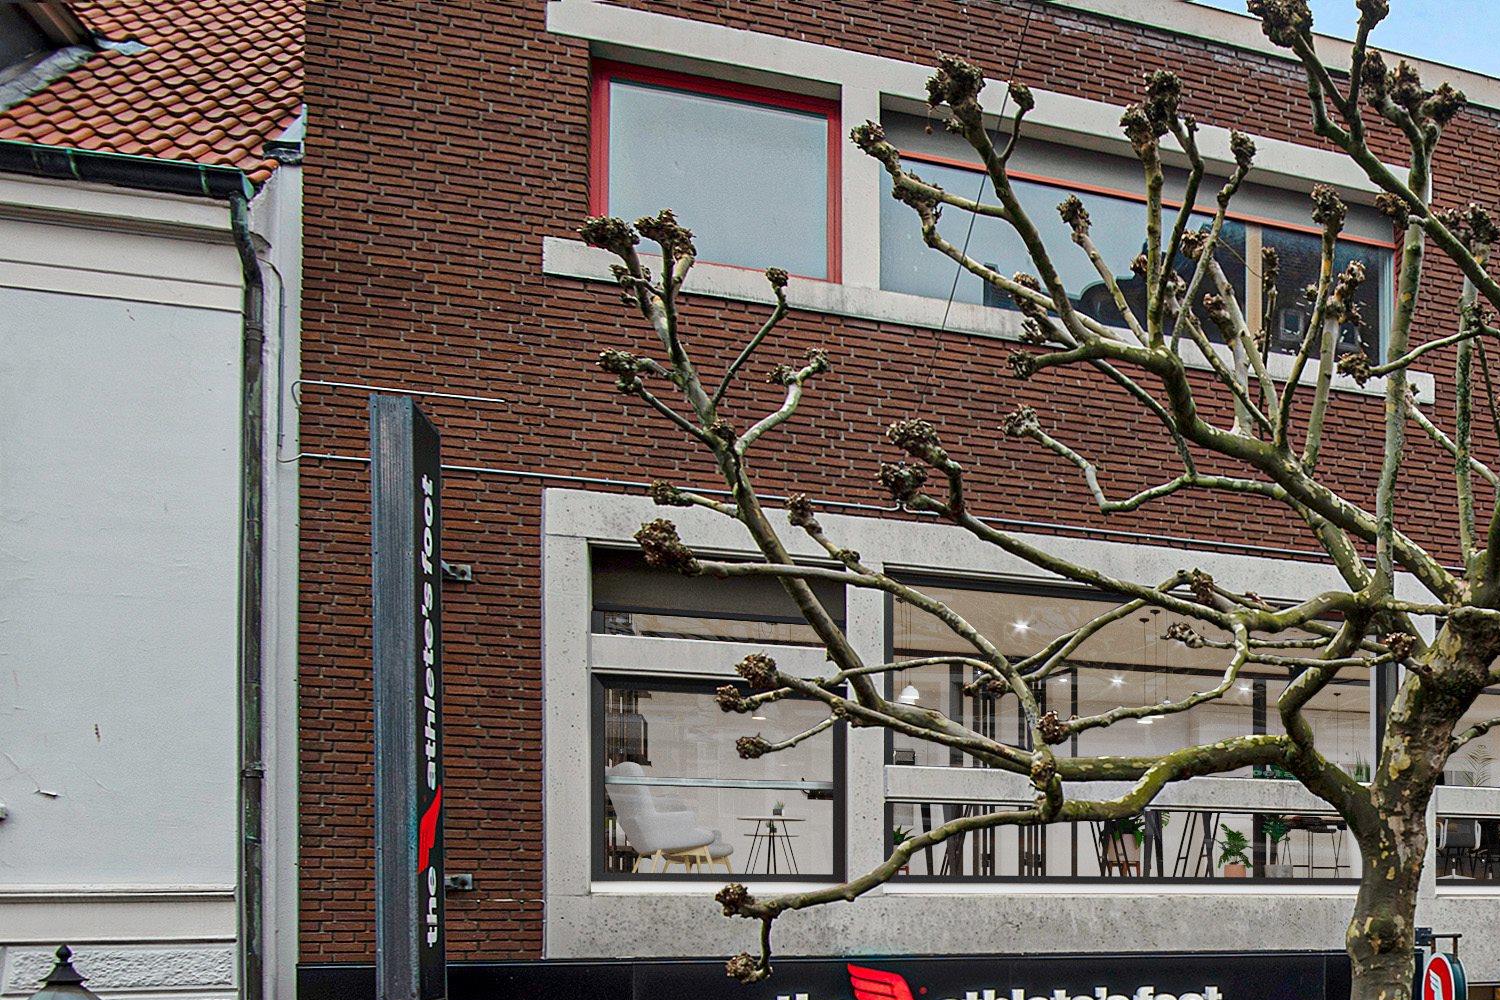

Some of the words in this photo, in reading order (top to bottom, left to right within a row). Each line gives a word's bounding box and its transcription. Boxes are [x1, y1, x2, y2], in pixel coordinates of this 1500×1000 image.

[420, 474, 436, 577] foot
[420, 582, 437, 791] athlete's
[426, 866, 438, 947] the
